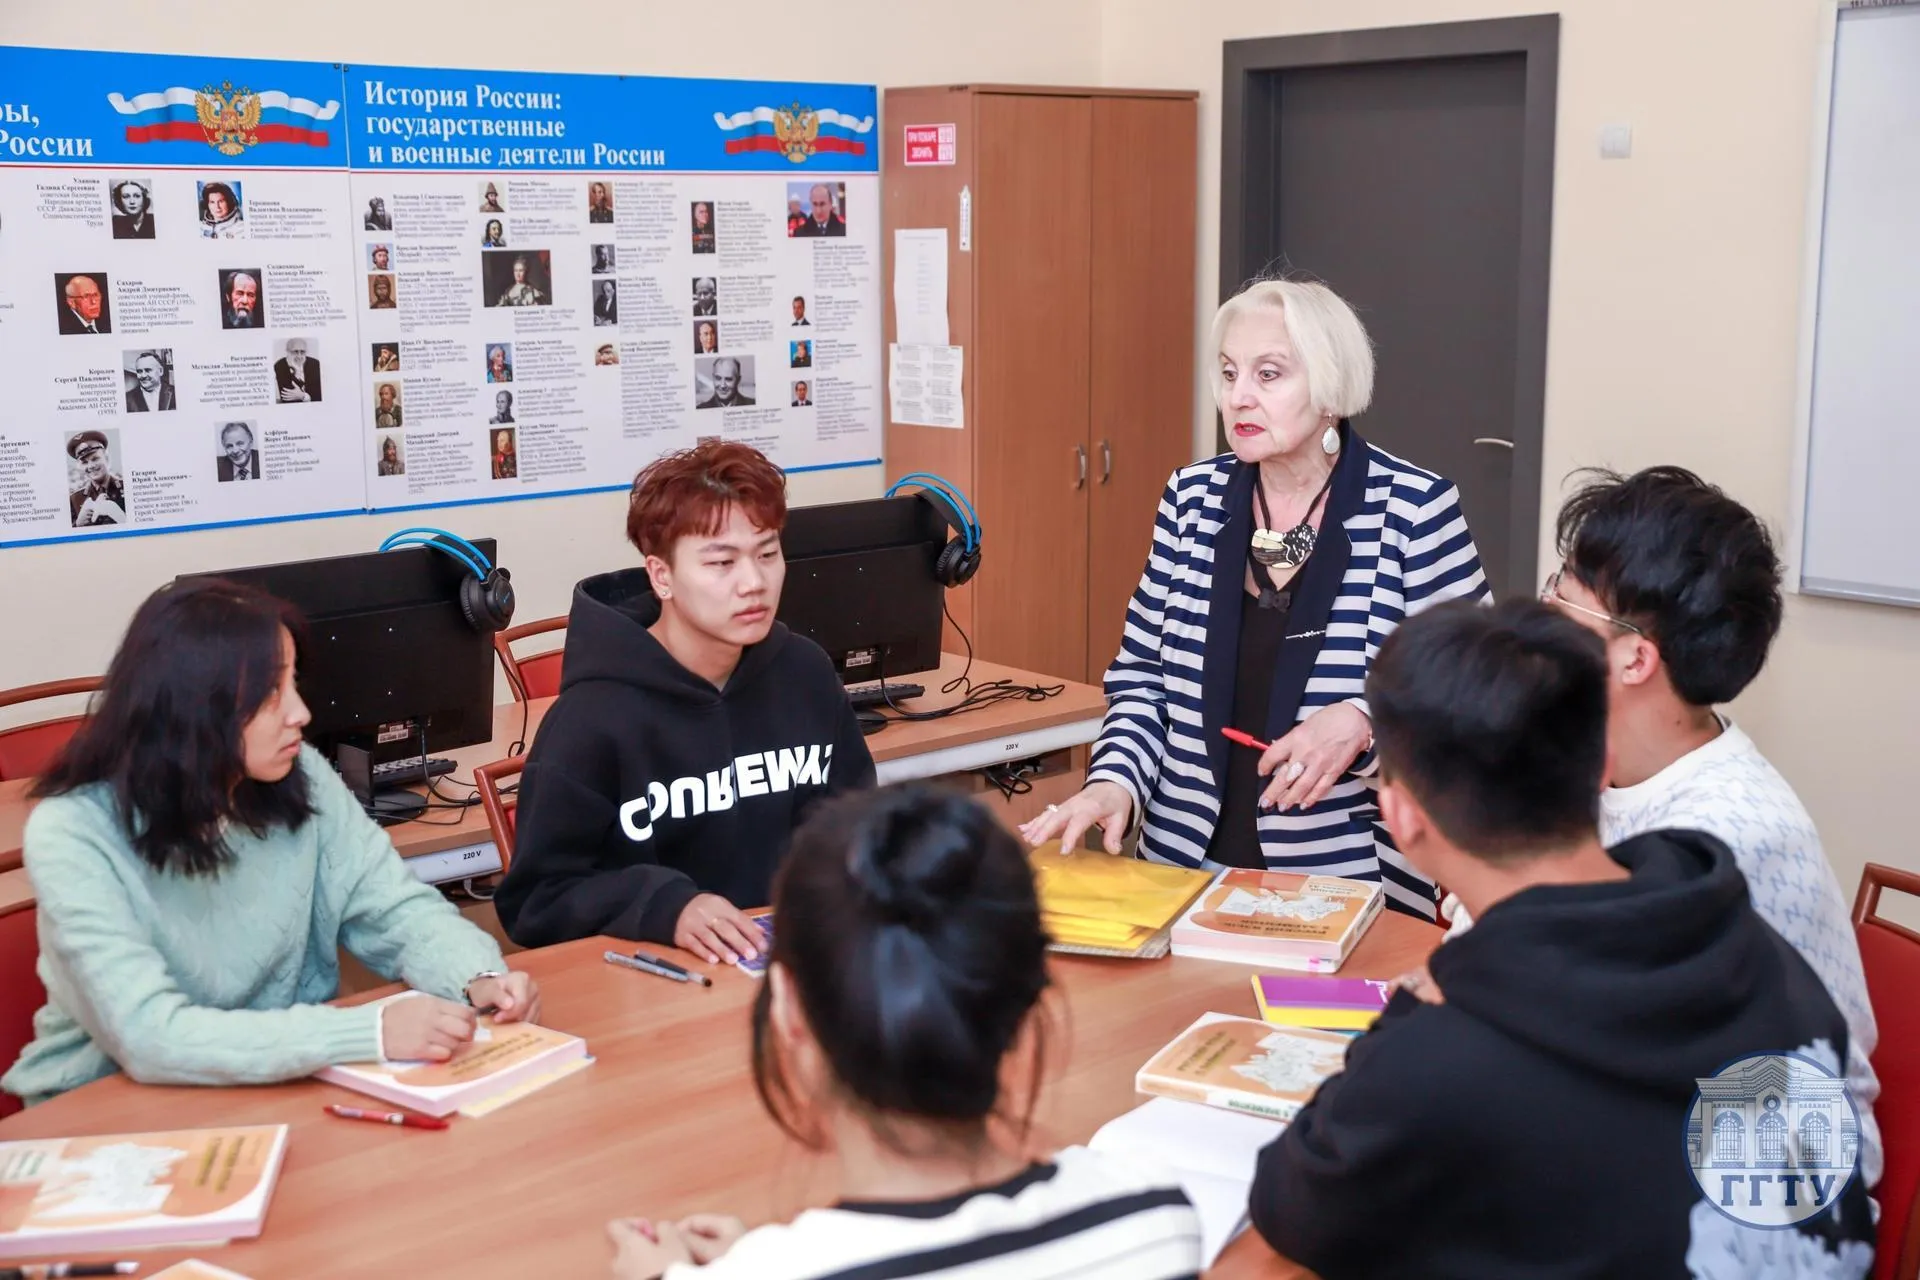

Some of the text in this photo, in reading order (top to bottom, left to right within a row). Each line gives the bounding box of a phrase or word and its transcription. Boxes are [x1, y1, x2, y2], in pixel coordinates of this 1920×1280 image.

[364, 80, 562, 112] История России:
[366, 116, 565, 142] государственные
[368, 143, 666, 168] и военные деятели России
[463, 852, 475, 860] 220
